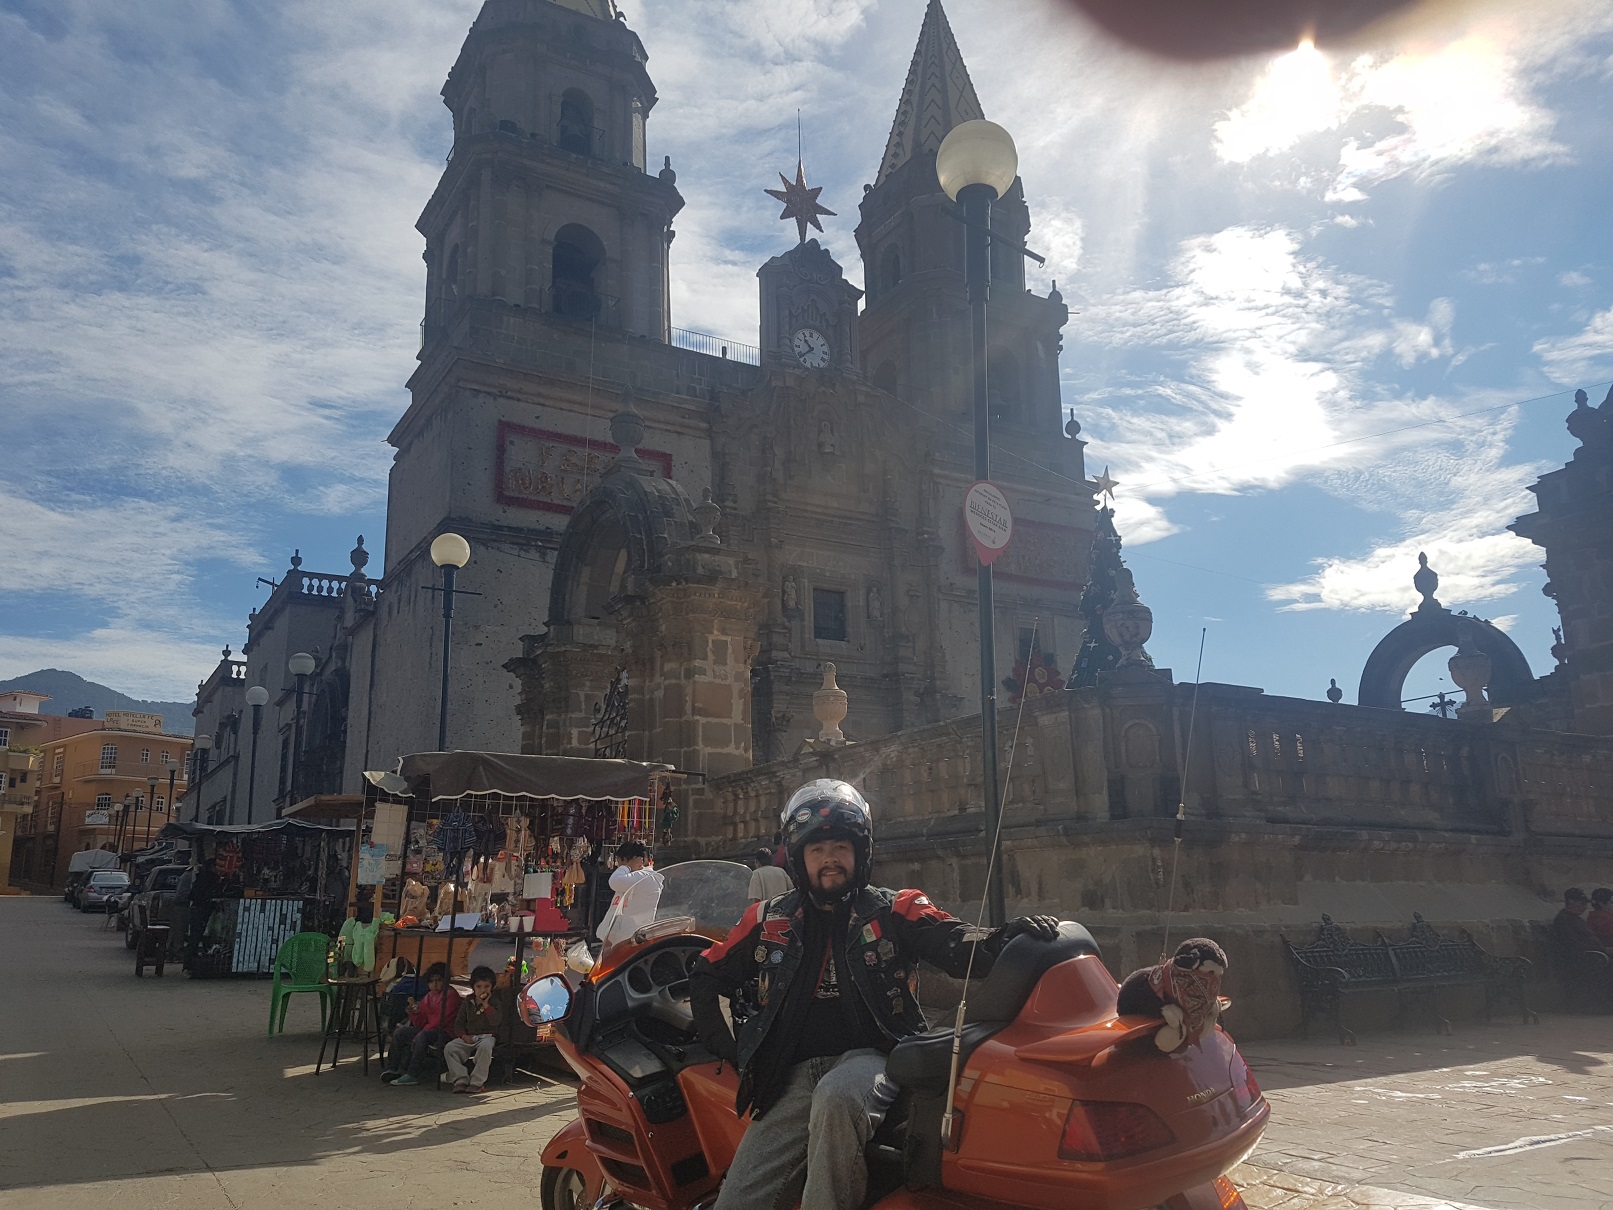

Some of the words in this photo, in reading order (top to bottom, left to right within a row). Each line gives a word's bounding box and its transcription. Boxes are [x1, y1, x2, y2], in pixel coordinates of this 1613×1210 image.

[970, 500, 1008, 528] BIENESTAR
[970, 509, 987, 521] MERECES
[988, 519, 998, 527] ESTAR
[1186, 1087, 1216, 1102] HONDA
